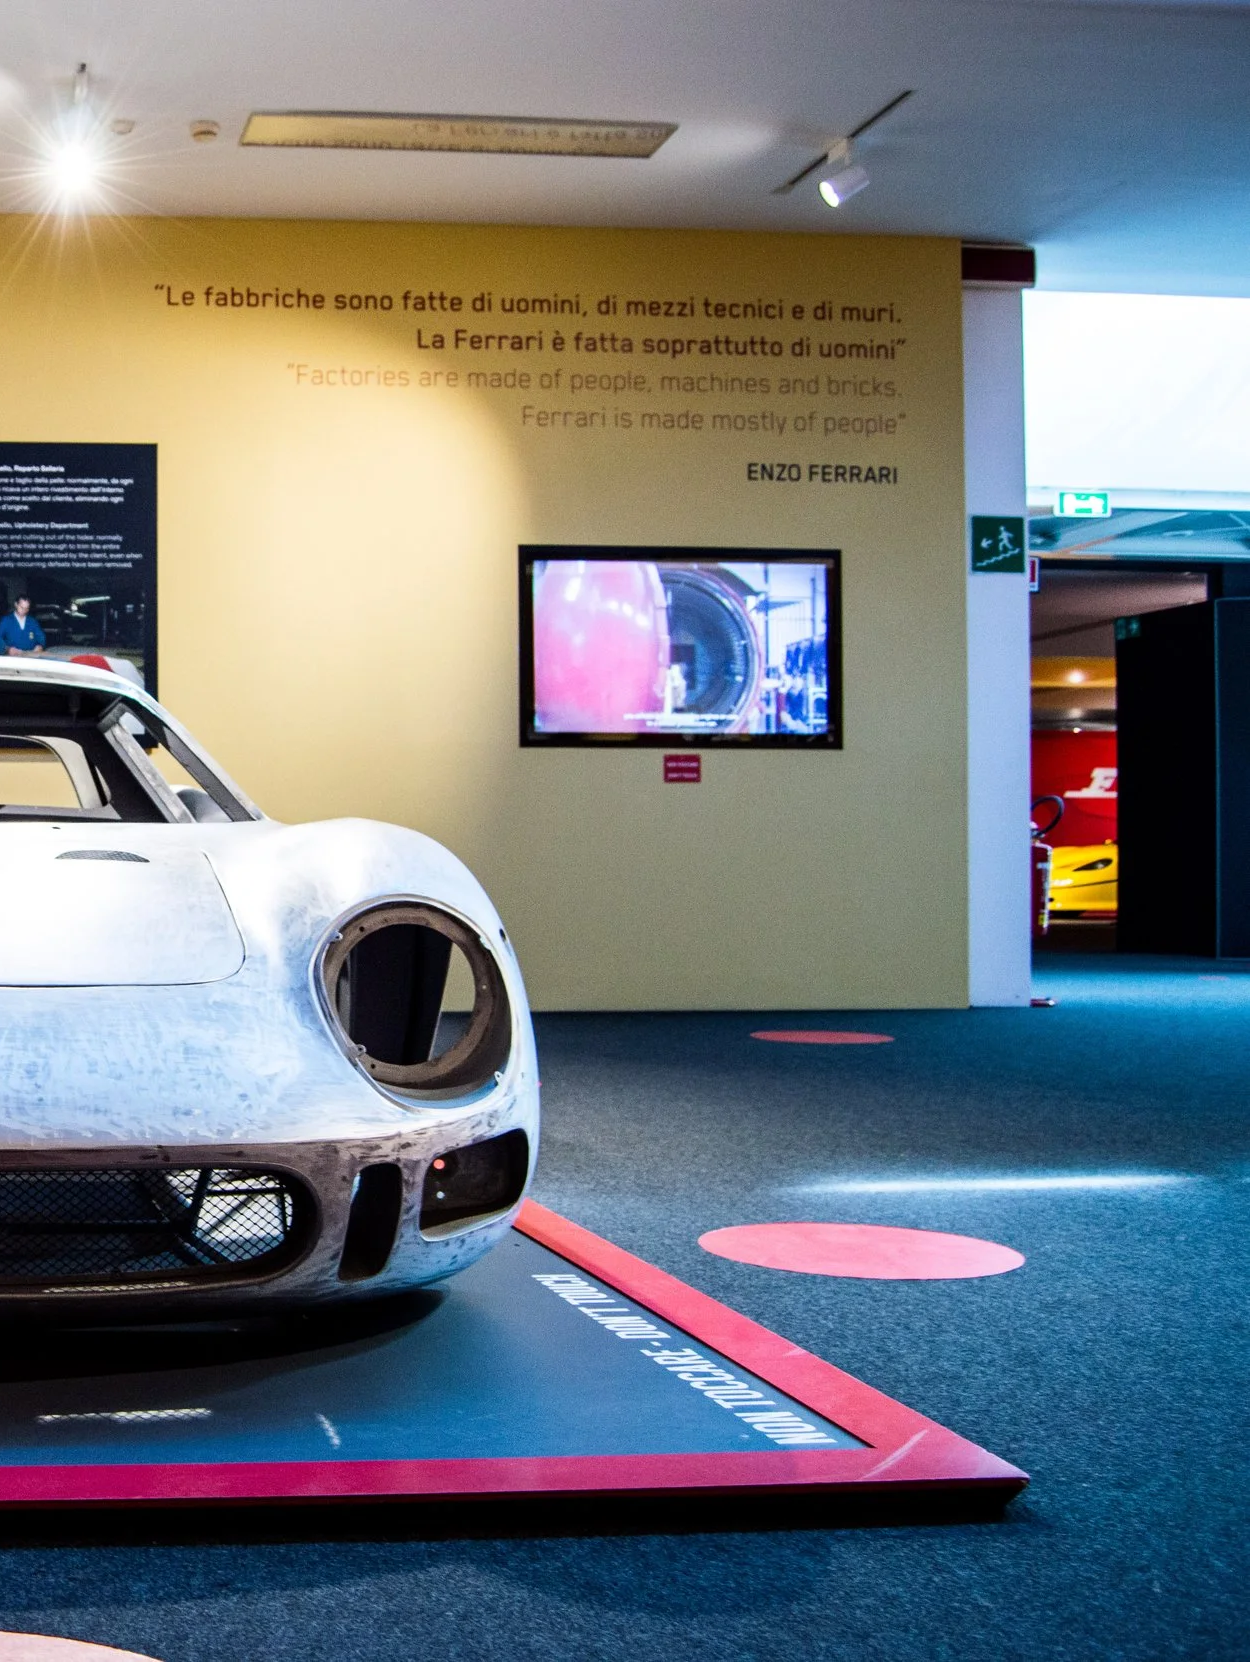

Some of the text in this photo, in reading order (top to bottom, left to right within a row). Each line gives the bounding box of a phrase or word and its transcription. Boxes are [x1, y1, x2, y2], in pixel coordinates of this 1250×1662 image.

[203, 285, 326, 310] fabbriche
[334, 293, 394, 312] sono
[401, 290, 464, 313] fatte
[471, 291, 493, 313] di
[500, 293, 588, 318] uomini,
[596, 294, 618, 316] di
[625, 296, 695, 318] mezzi
[702, 296, 784, 320] tecnici
[791, 304, 805, 321] e
[812, 300, 833, 322] di
[840, 302, 902, 324] muri.
[416, 328, 445, 350] La
[454, 328, 544, 352] Ferrari
[551, 330, 566, 353] è
[573, 331, 634, 354] fatta
[642, 334, 784, 360] soprattutto
[790, 336, 811, 358] di
[419, 371, 459, 388] are
[466, 368, 532, 391] made
[539, 367, 563, 390] of
[569, 368, 652, 396] people,
[659, 373, 771, 394] machines
[779, 373, 819, 395] and
[827, 374, 902, 397] bricks.
[521, 404, 607, 428] Ferrari
[613, 406, 632, 428] is
[641, 407, 704, 430] made
[711, 408, 786, 435] mostly
[793, 409, 817, 431] of
[746, 461, 898, 485] ENZO FERRARI
[531, 1274, 616, 1305] TOUCH
[640, 1348, 777, 1409] TOCCARE
[734, 1411, 838, 1445] NON
